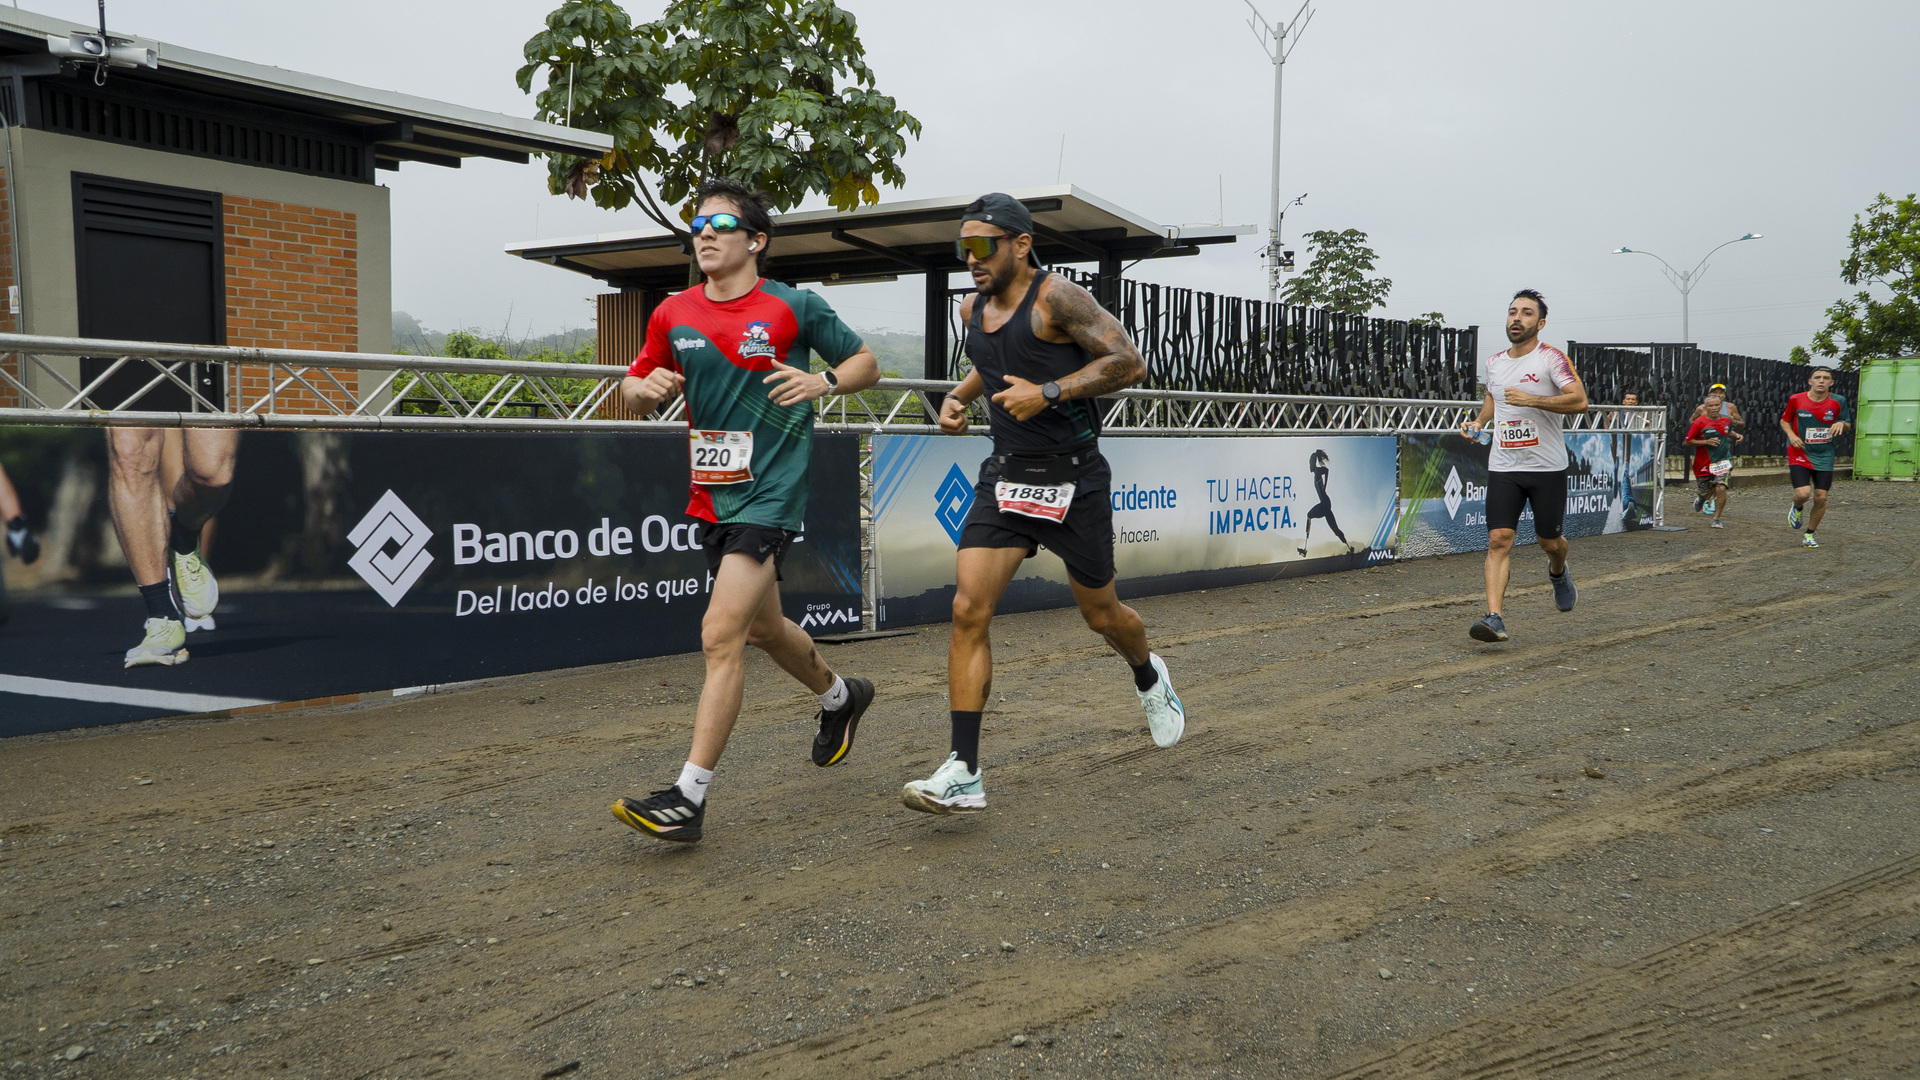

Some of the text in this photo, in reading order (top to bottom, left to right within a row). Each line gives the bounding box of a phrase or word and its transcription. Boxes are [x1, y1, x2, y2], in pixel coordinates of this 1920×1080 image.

[1503, 428, 1530, 440] 1804
[696, 448, 731, 467] 220
[1206, 476, 1296, 503] TU HACER,
[1466, 481, 1488, 501] Ban
[1580, 473, 1611, 492] HACER,
[1008, 487, 1058, 503] 1883
[1110, 483, 1177, 511] cidente
[1567, 494, 1611, 515] IMPACTA.
[1209, 505, 1297, 535] IMPACTA.
[453, 523, 579, 566] Banco
[588, 517, 633, 556] de
[1120, 526, 1160, 544] hacen.
[1368, 549, 1393, 561] AVAL
[456, 585, 502, 617] Del
[510, 582, 570, 611] lado
[575, 578, 607, 605] de
[615, 576, 649, 601] los
[656, 578, 698, 604] que
[807, 603, 831, 612] Grupo
[800, 607, 860, 629] AVAL
